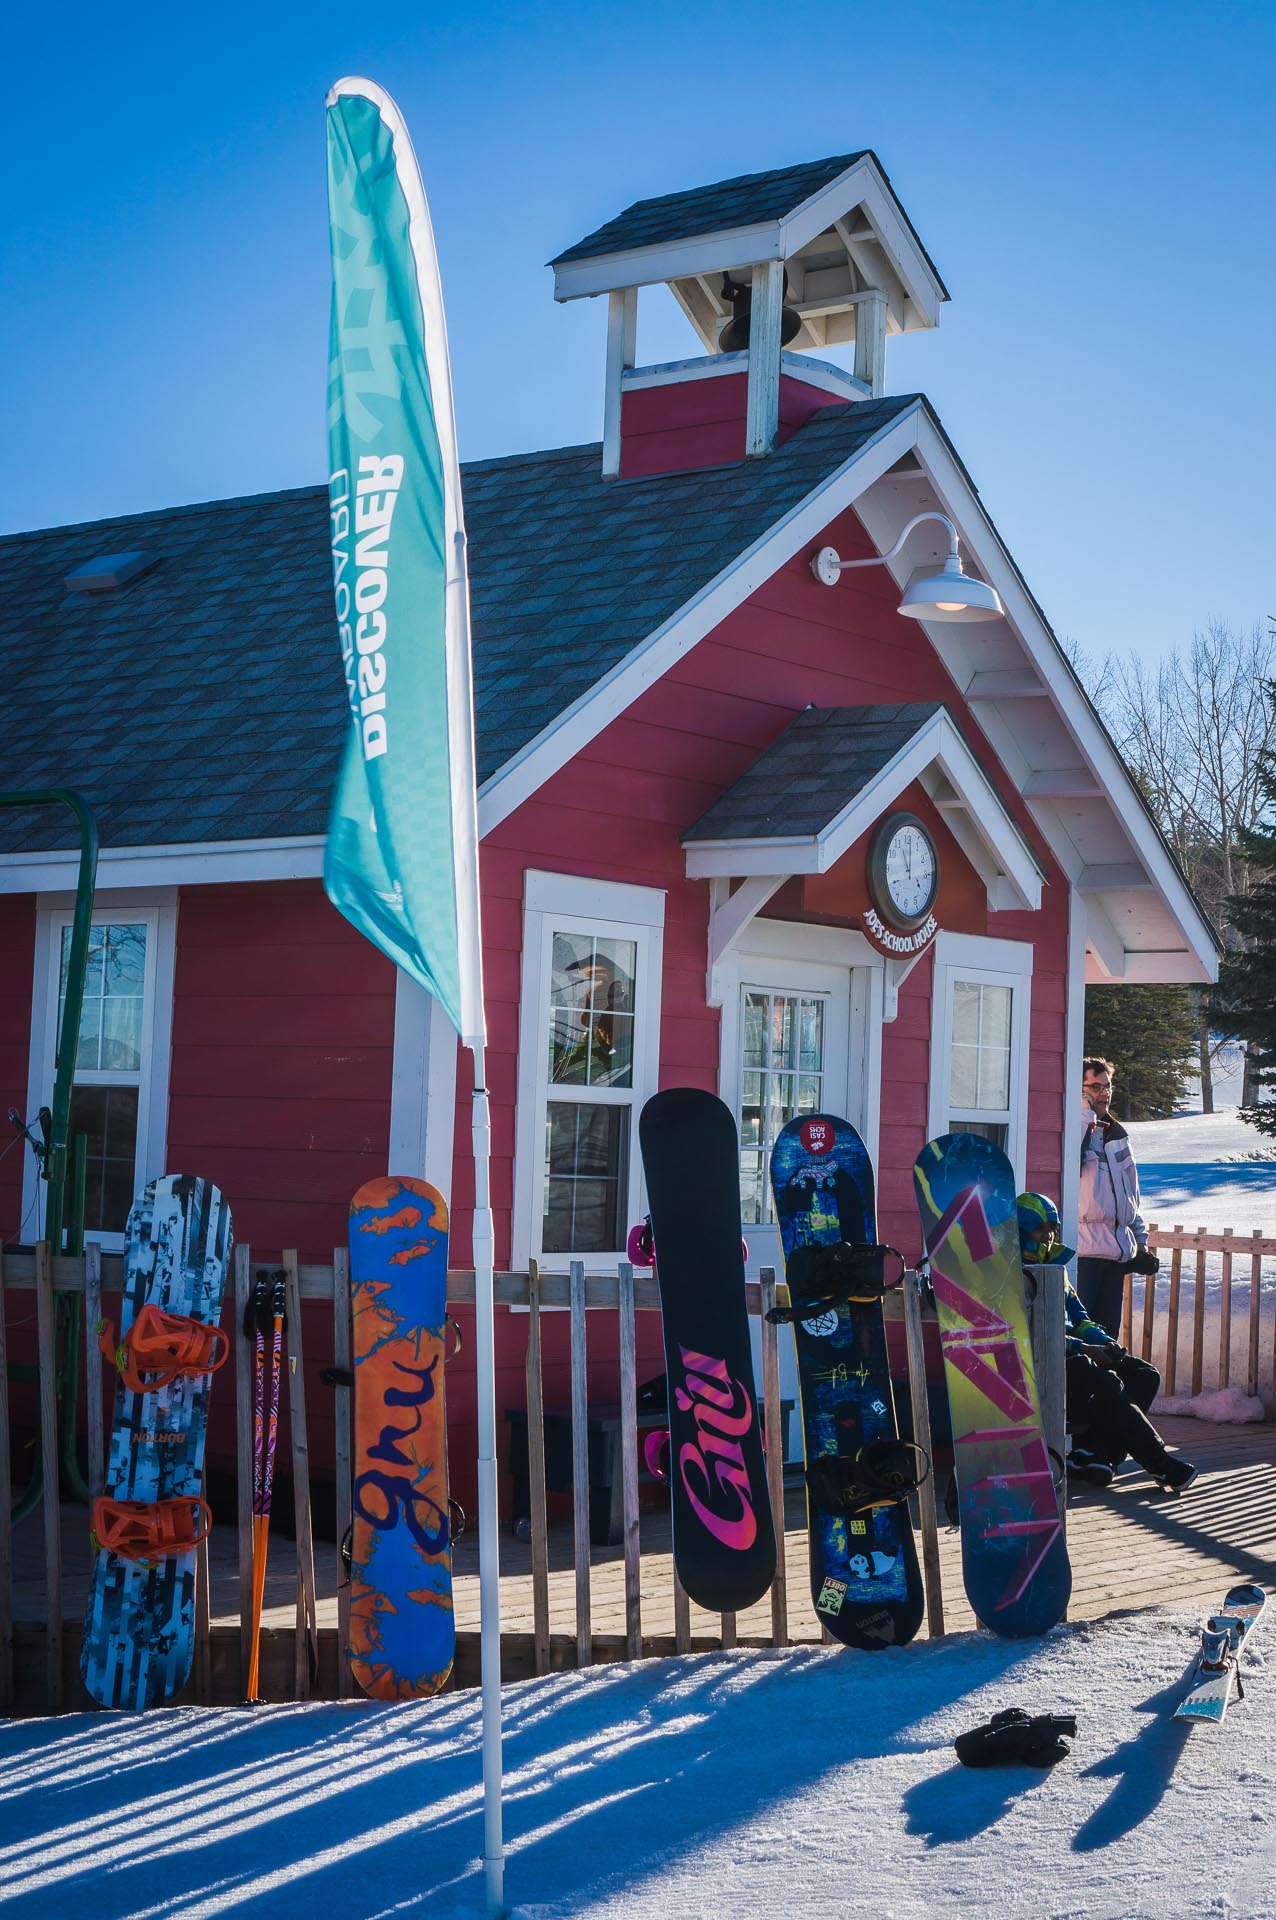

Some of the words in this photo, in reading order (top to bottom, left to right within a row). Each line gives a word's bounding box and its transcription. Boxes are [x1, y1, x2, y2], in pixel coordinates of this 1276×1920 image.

[894, 838, 901, 849] 11
[904, 834, 911, 845] 12
[889, 849, 897, 859] 10
[882, 931, 914, 952] SCHOOL
[915, 914, 937, 948] HOUSE
[132, 1431, 186, 1444] BURTON
[354, 1354, 449, 1555] gnu
[825, 1579, 846, 1592] OBEY
